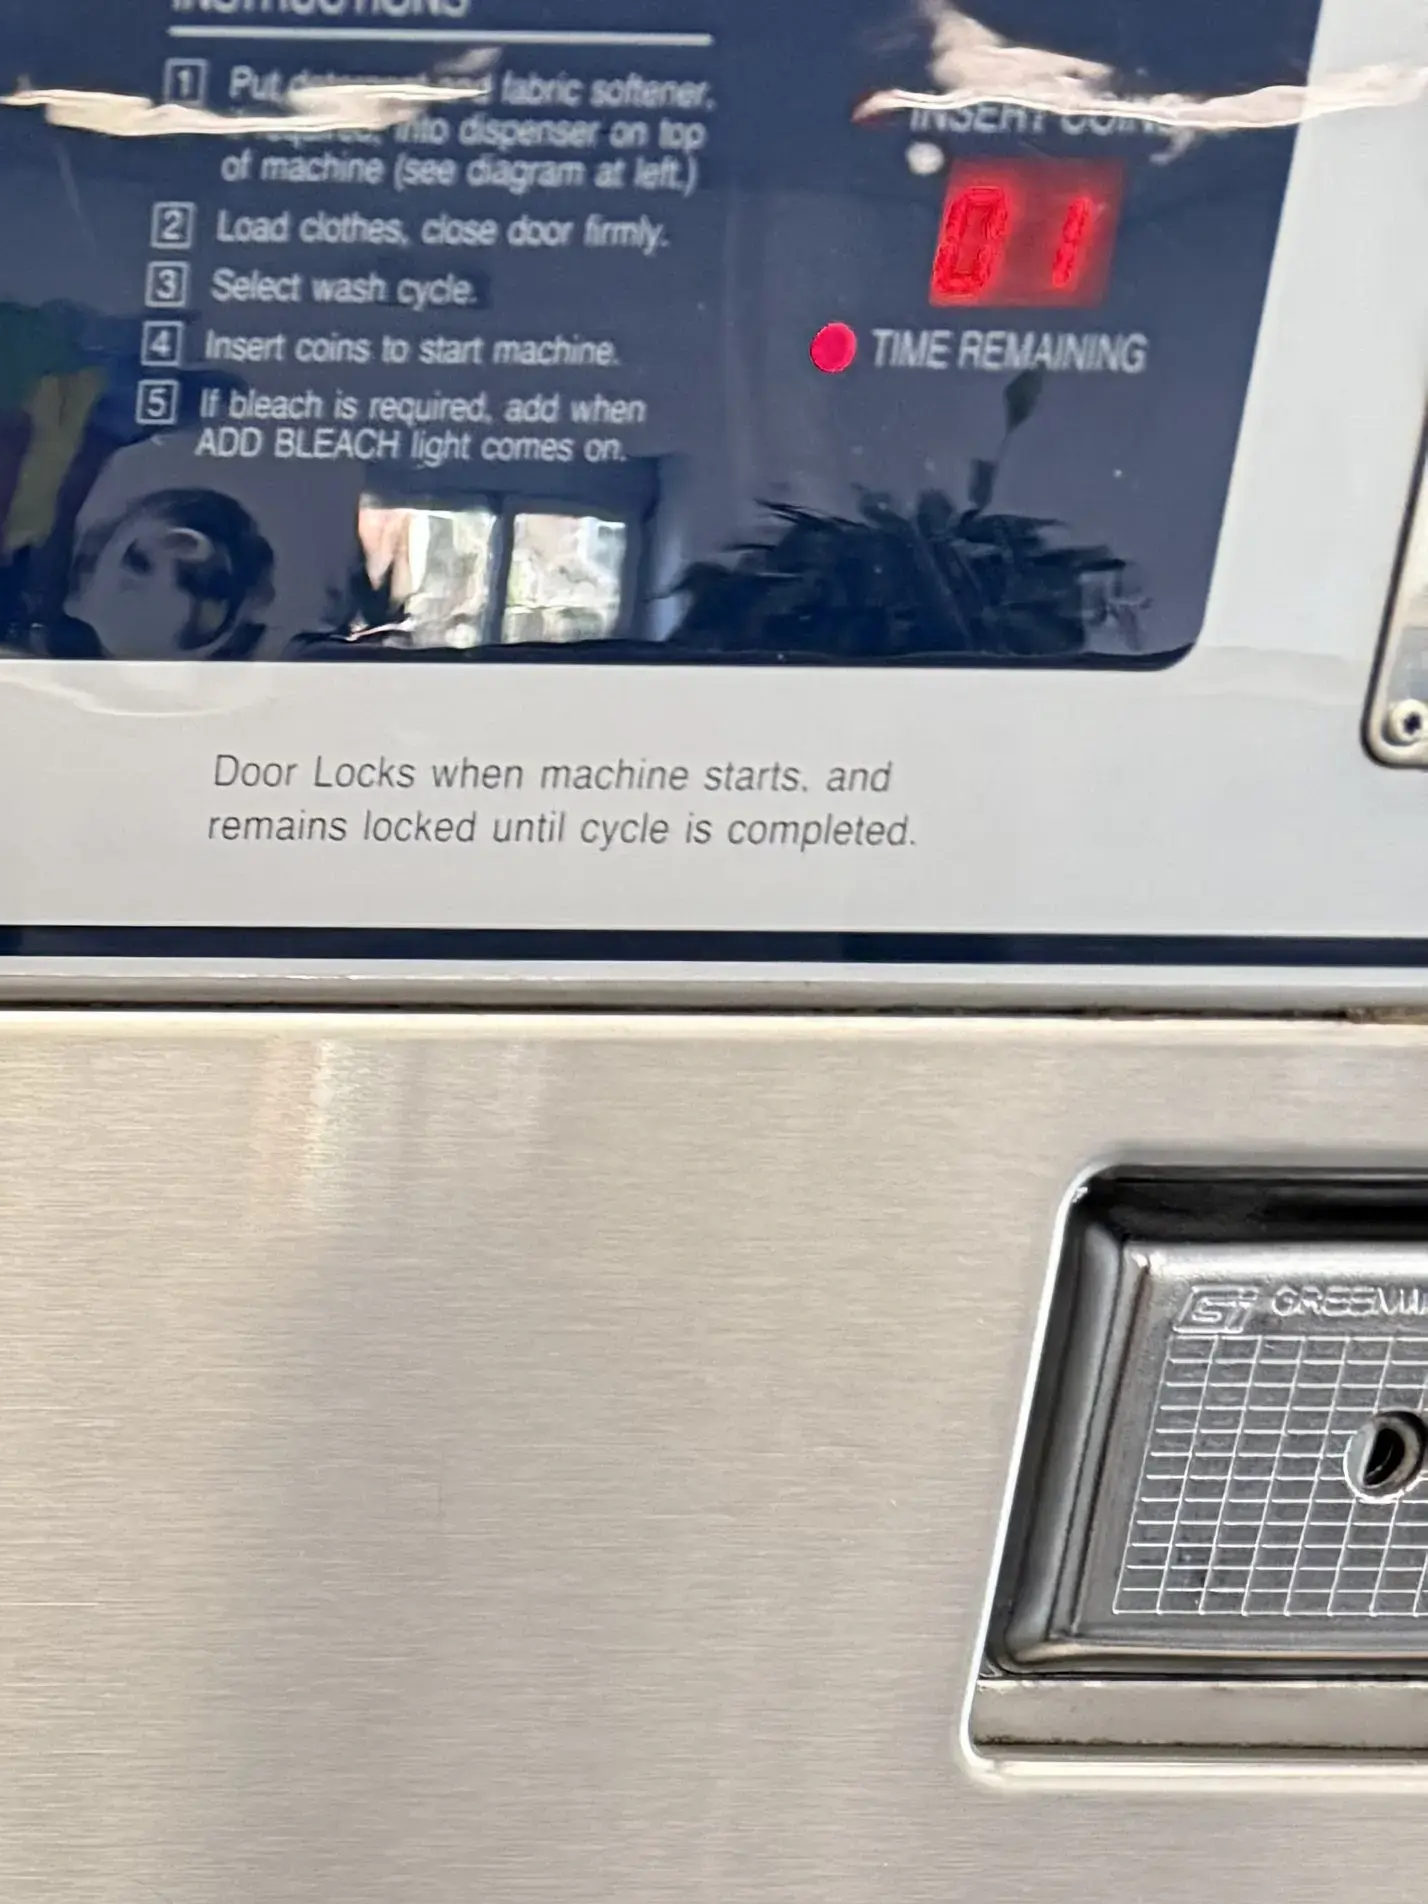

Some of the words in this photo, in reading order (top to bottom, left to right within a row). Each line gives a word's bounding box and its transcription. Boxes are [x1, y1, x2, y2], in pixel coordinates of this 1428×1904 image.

[229, 65, 283, 102] Put
[500, 70, 582, 107] fabric
[459, 111, 600, 152] dispenser
[609, 122, 646, 149] on
[659, 119, 706, 152] top
[221, 150, 251, 182] of
[261, 152, 384, 184] machine
[394, 154, 456, 190] (see
[467, 155, 584, 195] diagram
[595, 161, 625, 189] at
[218, 211, 288, 243] Load
[422, 213, 496, 245] close
[508, 214, 571, 246] door
[584, 214, 670, 255] firmly.
[929, 185, 1096, 297] 01
[212, 269, 300, 302] Select
[313, 272, 386, 303] wash
[397, 272, 478, 309] cycle.
[205, 329, 285, 361] Insert
[296, 332, 370, 362] coins
[383, 334, 407, 363] to
[419, 335, 483, 365] start
[494, 334, 621, 366] machine.
[872, 329, 951, 368] TIME
[958, 330, 1148, 373] REMAINING
[201, 388, 220, 418] If
[230, 389, 322, 420] bleach
[336, 391, 357, 420] is
[505, 394, 561, 424] add
[571, 395, 647, 424] when
[195, 428, 261, 458] ADD
[274, 428, 400, 460] BLEACH
[412, 428, 471, 468] light
[482, 436, 572, 462] comes
[584, 437, 627, 463] on.
[214, 755, 298, 788] Door
[314, 755, 416, 790] Locks
[431, 756, 524, 790] when
[540, 757, 689, 792] machine
[826, 761, 893, 793] and
[208, 809, 347, 841] remains
[363, 808, 475, 842] locked
[492, 809, 566, 843] until
[579, 811, 669, 852] cycle
[685, 813, 712, 844] is
[727, 813, 917, 853] completed.
